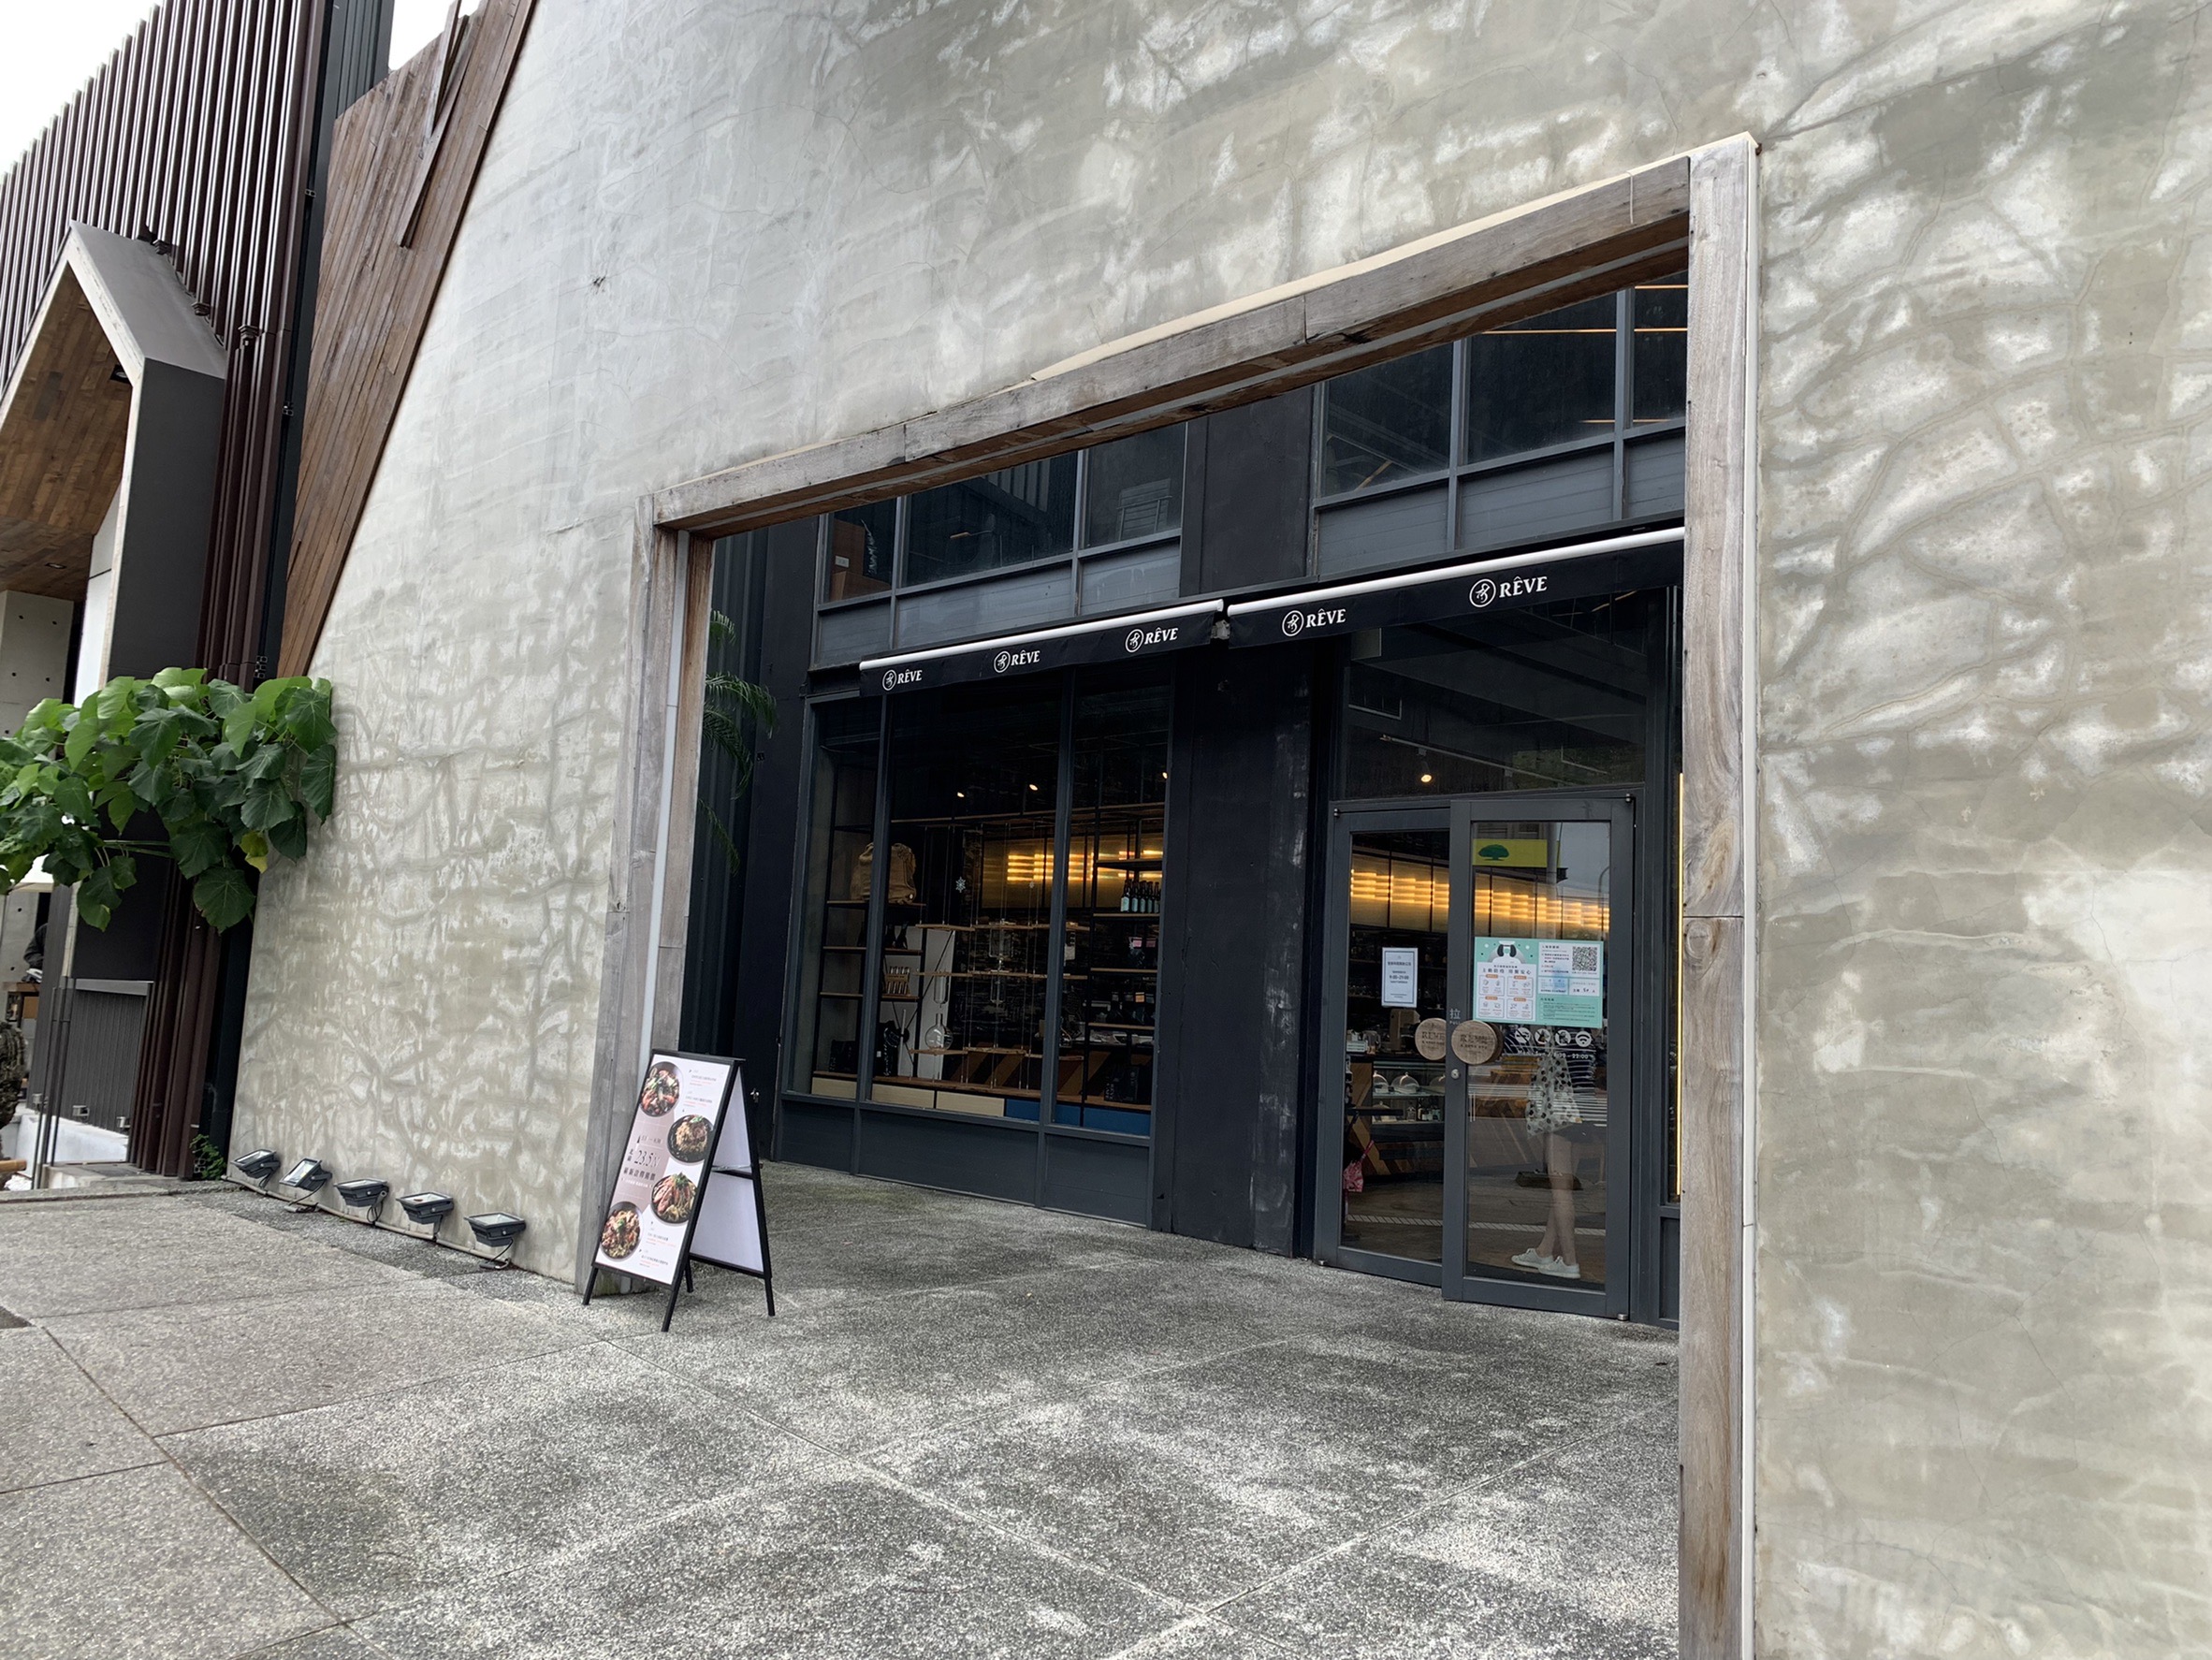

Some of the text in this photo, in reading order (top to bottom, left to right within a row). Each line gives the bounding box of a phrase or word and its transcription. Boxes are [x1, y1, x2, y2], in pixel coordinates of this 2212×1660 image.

[1499, 575, 1548, 598] RÊVE
[1305, 608, 1346, 629] RÊVE
[1143, 627, 1179, 645] RÊVE
[1011, 649, 1041, 666] RÊVE
[896, 668, 923, 685] RÊVE
